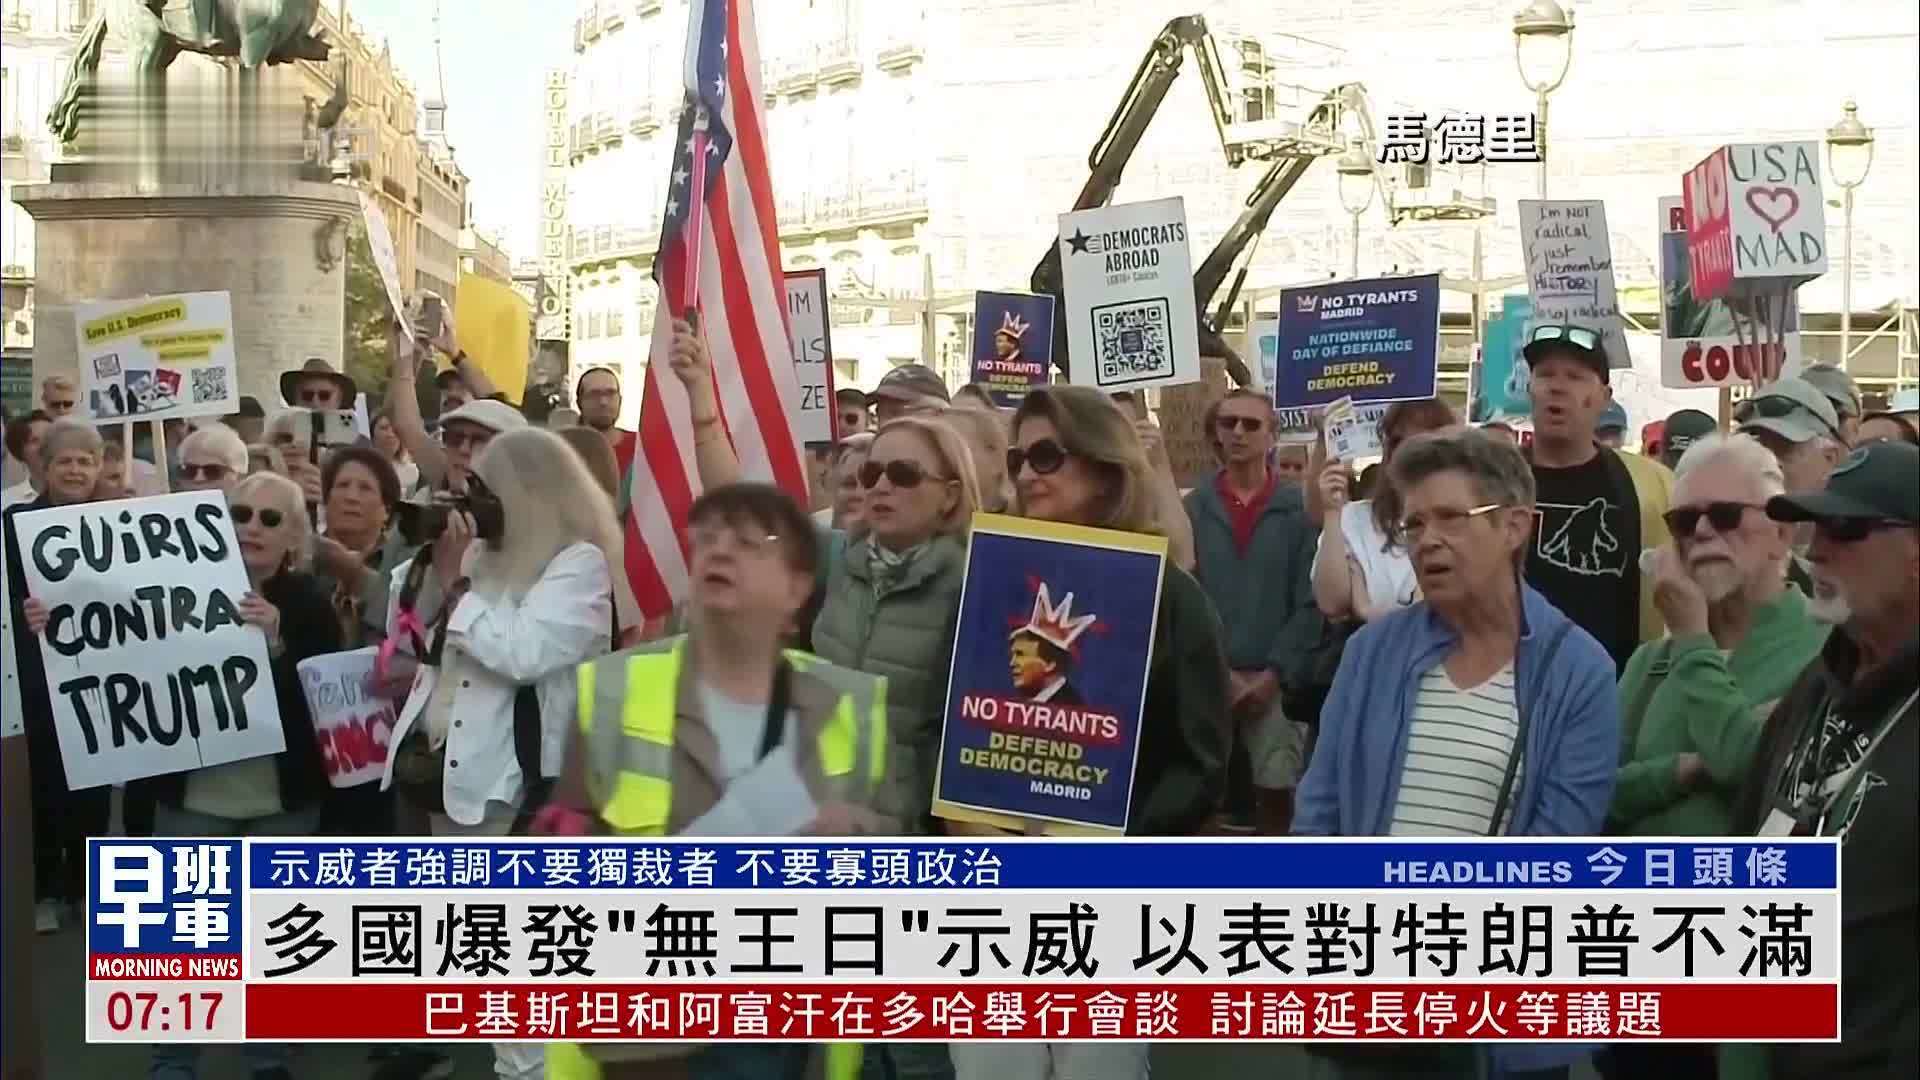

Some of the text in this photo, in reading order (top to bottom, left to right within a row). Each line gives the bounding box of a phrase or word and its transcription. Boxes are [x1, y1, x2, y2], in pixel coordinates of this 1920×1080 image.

[546, 70, 568, 168] HOTEL
[1728, 145, 1816, 185] USA
[1567, 207, 1591, 219] NOT
[1103, 222, 1184, 251] DEMOCRATS
[1105, 248, 1159, 273] ABROAD
[1736, 231, 1822, 270] MAD
[1322, 290, 1418, 309] NO TYRANTS
[1320, 307, 1364, 319] MADRID
[1293, 339, 1413, 360] DAY OF DEFIANCE
[1309, 328, 1397, 346] NATIONWIDE
[977, 360, 1042, 375] NO TYRANTS
[1324, 361, 1379, 376] DEFEND
[1307, 373, 1395, 391] DEMOCRACY
[45, 585, 245, 657] CONTRA
[58, 655, 258, 755] TRUMP
[962, 695, 1118, 738] NO TYRANTS
[989, 731, 1083, 760] DEFEND
[959, 747, 1109, 785] DEMOCRACY
[1030, 780, 1092, 800] MADRID
